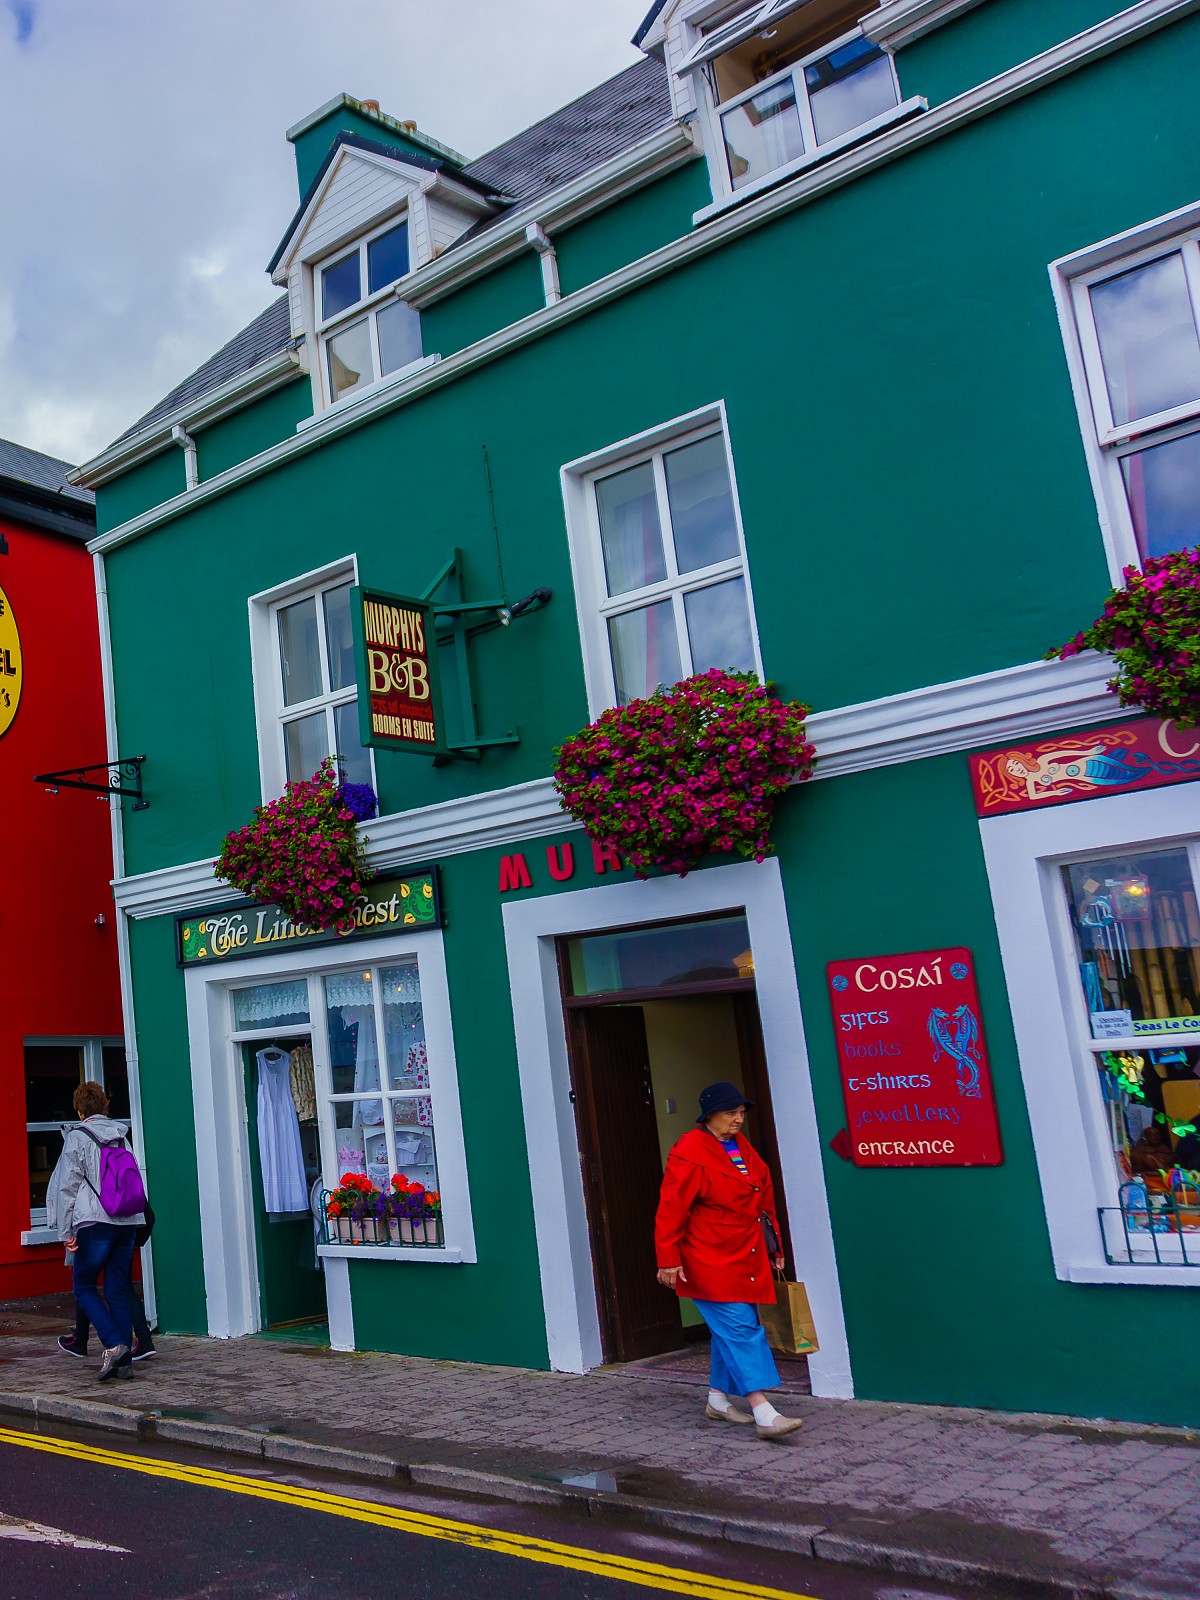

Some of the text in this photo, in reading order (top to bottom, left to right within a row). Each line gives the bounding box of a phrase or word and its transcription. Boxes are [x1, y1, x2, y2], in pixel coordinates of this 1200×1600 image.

[364, 601, 425, 656] MURPHYS
[367, 649, 430, 701] B&B
[372, 713, 435, 741] ROOMS EN SUITE
[206, 914, 248, 956] The
[855, 957, 943, 993] Cosaí
[840, 1010, 889, 1032] gifts
[1134, 1018, 1200, 1032] Seas Le Co
[844, 1040, 902, 1059] books
[856, 1104, 961, 1128] jewellery
[858, 1139, 955, 1156] entrance
